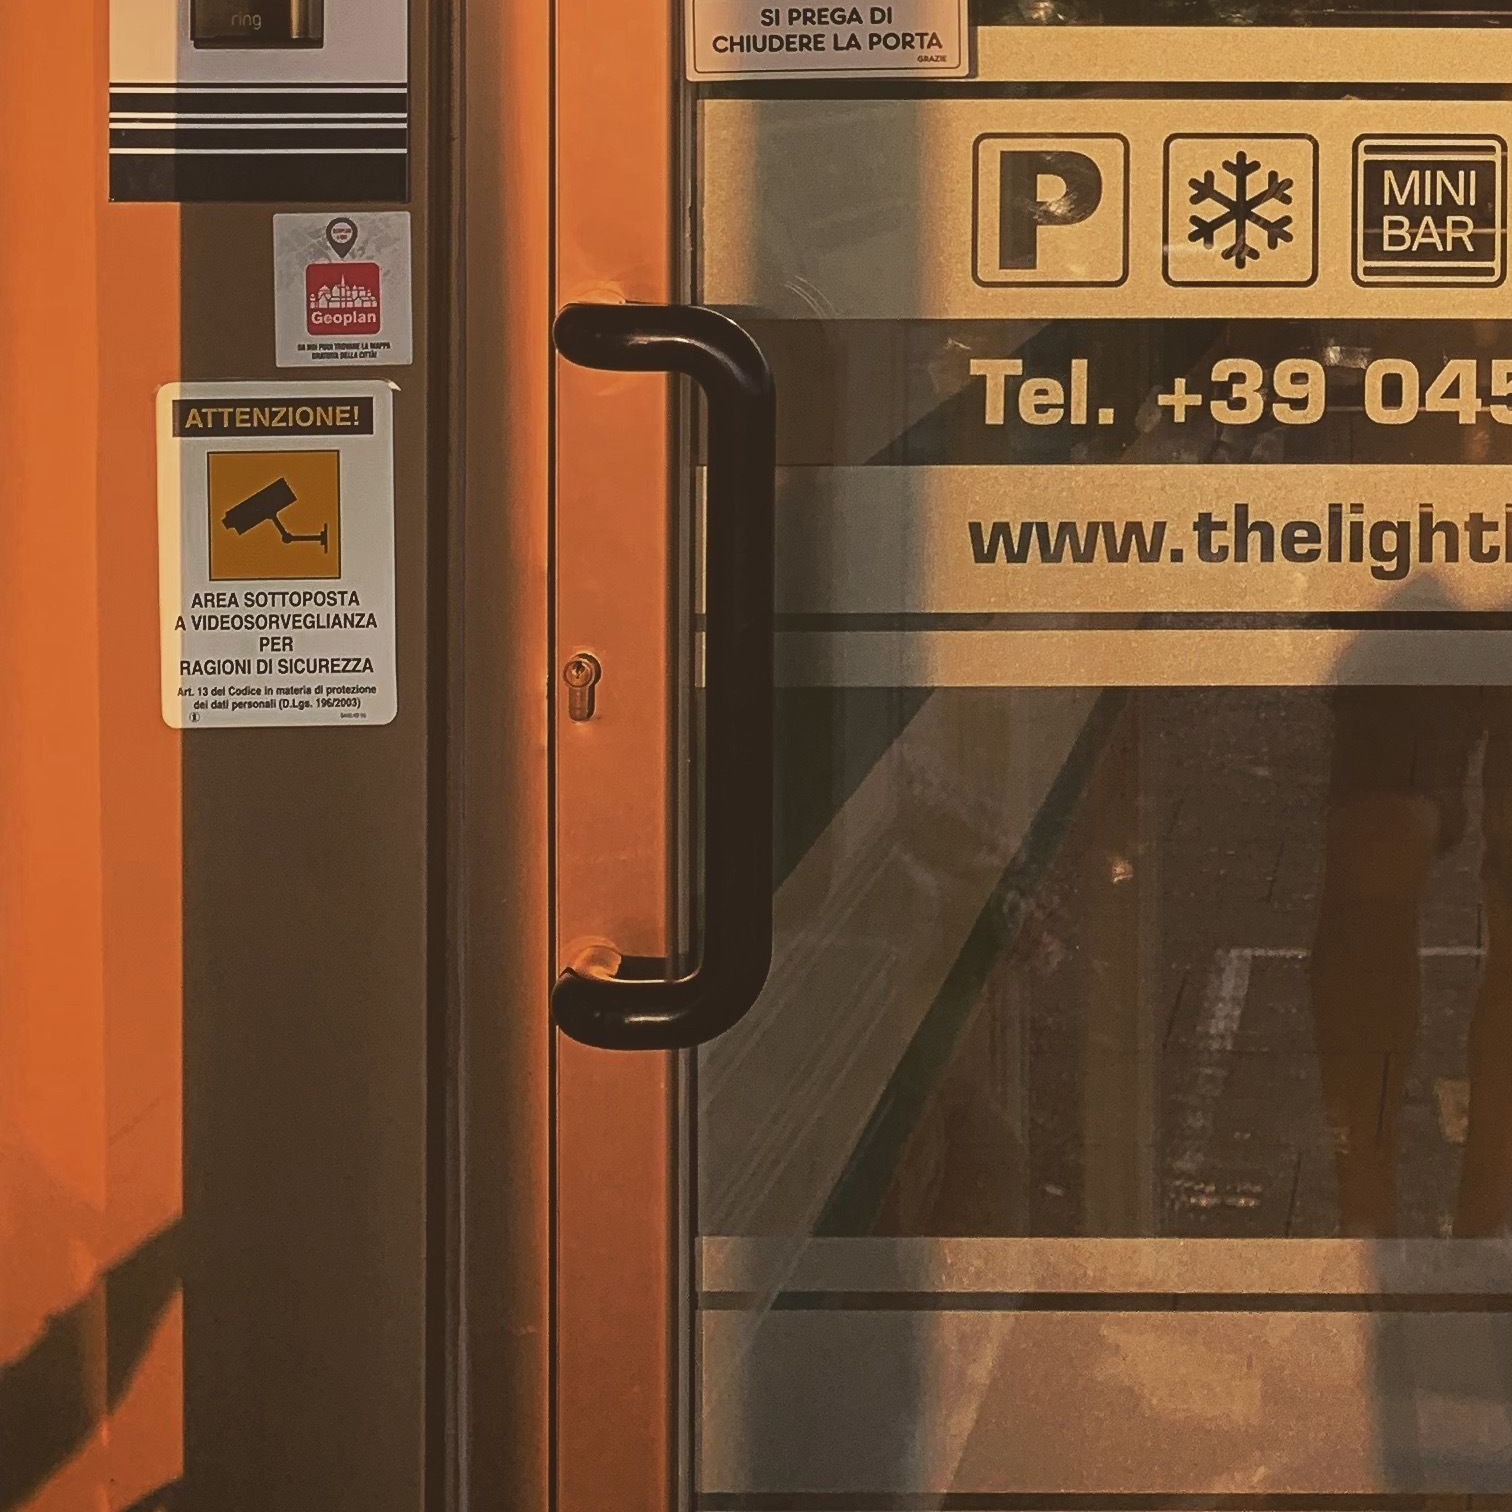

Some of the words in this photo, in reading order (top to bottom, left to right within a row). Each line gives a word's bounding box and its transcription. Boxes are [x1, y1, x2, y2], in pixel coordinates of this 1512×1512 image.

[231, 12, 262, 30] ring
[760, 8, 780, 26] SI
[788, 7, 864, 26] PREGA
[869, 6, 893, 25] DI
[712, 33, 826, 54] CHIUDERE
[833, 32, 861, 52] LA
[868, 32, 943, 51] PORTA
[917, 54, 948, 63] GRAZIE
[1382, 169, 1477, 207] MINI
[1000, 150, 1103, 270] P
[1382, 215, 1476, 253] BAR
[311, 310, 377, 327] Geoplan
[970, 358, 1116, 426] Tel.
[1157, 358, 1327, 427] +39
[184, 406, 360, 429] ATTENZIONE!
[190, 592, 239, 609] AREA
[243, 591, 360, 608] SOTTOPOSTA
[174, 616, 187, 631] A
[191, 613, 378, 630] VIDEOSORVEGLIANZA
[259, 637, 294, 652] PER
[179, 660, 251, 676] RAGIONI
[256, 659, 273, 675] DI
[277, 657, 374, 675] SICUREZZA
[177, 687, 195, 697] Art.
[198, 687, 209, 697] 13
[211, 686, 226, 696] del
[228, 686, 262, 696] Codice
[264, 686, 274, 696] in
[275, 685, 312, 695] materia
[314, 685, 324, 695] di
[326, 685, 377, 697] protezione
[193, 700, 209, 710] dei
[210, 699, 229, 710] dati
[231, 699, 277, 711] personali
[278, 698, 313, 711] (D.Lgs.
[316, 697, 361, 709] 196/2003)
